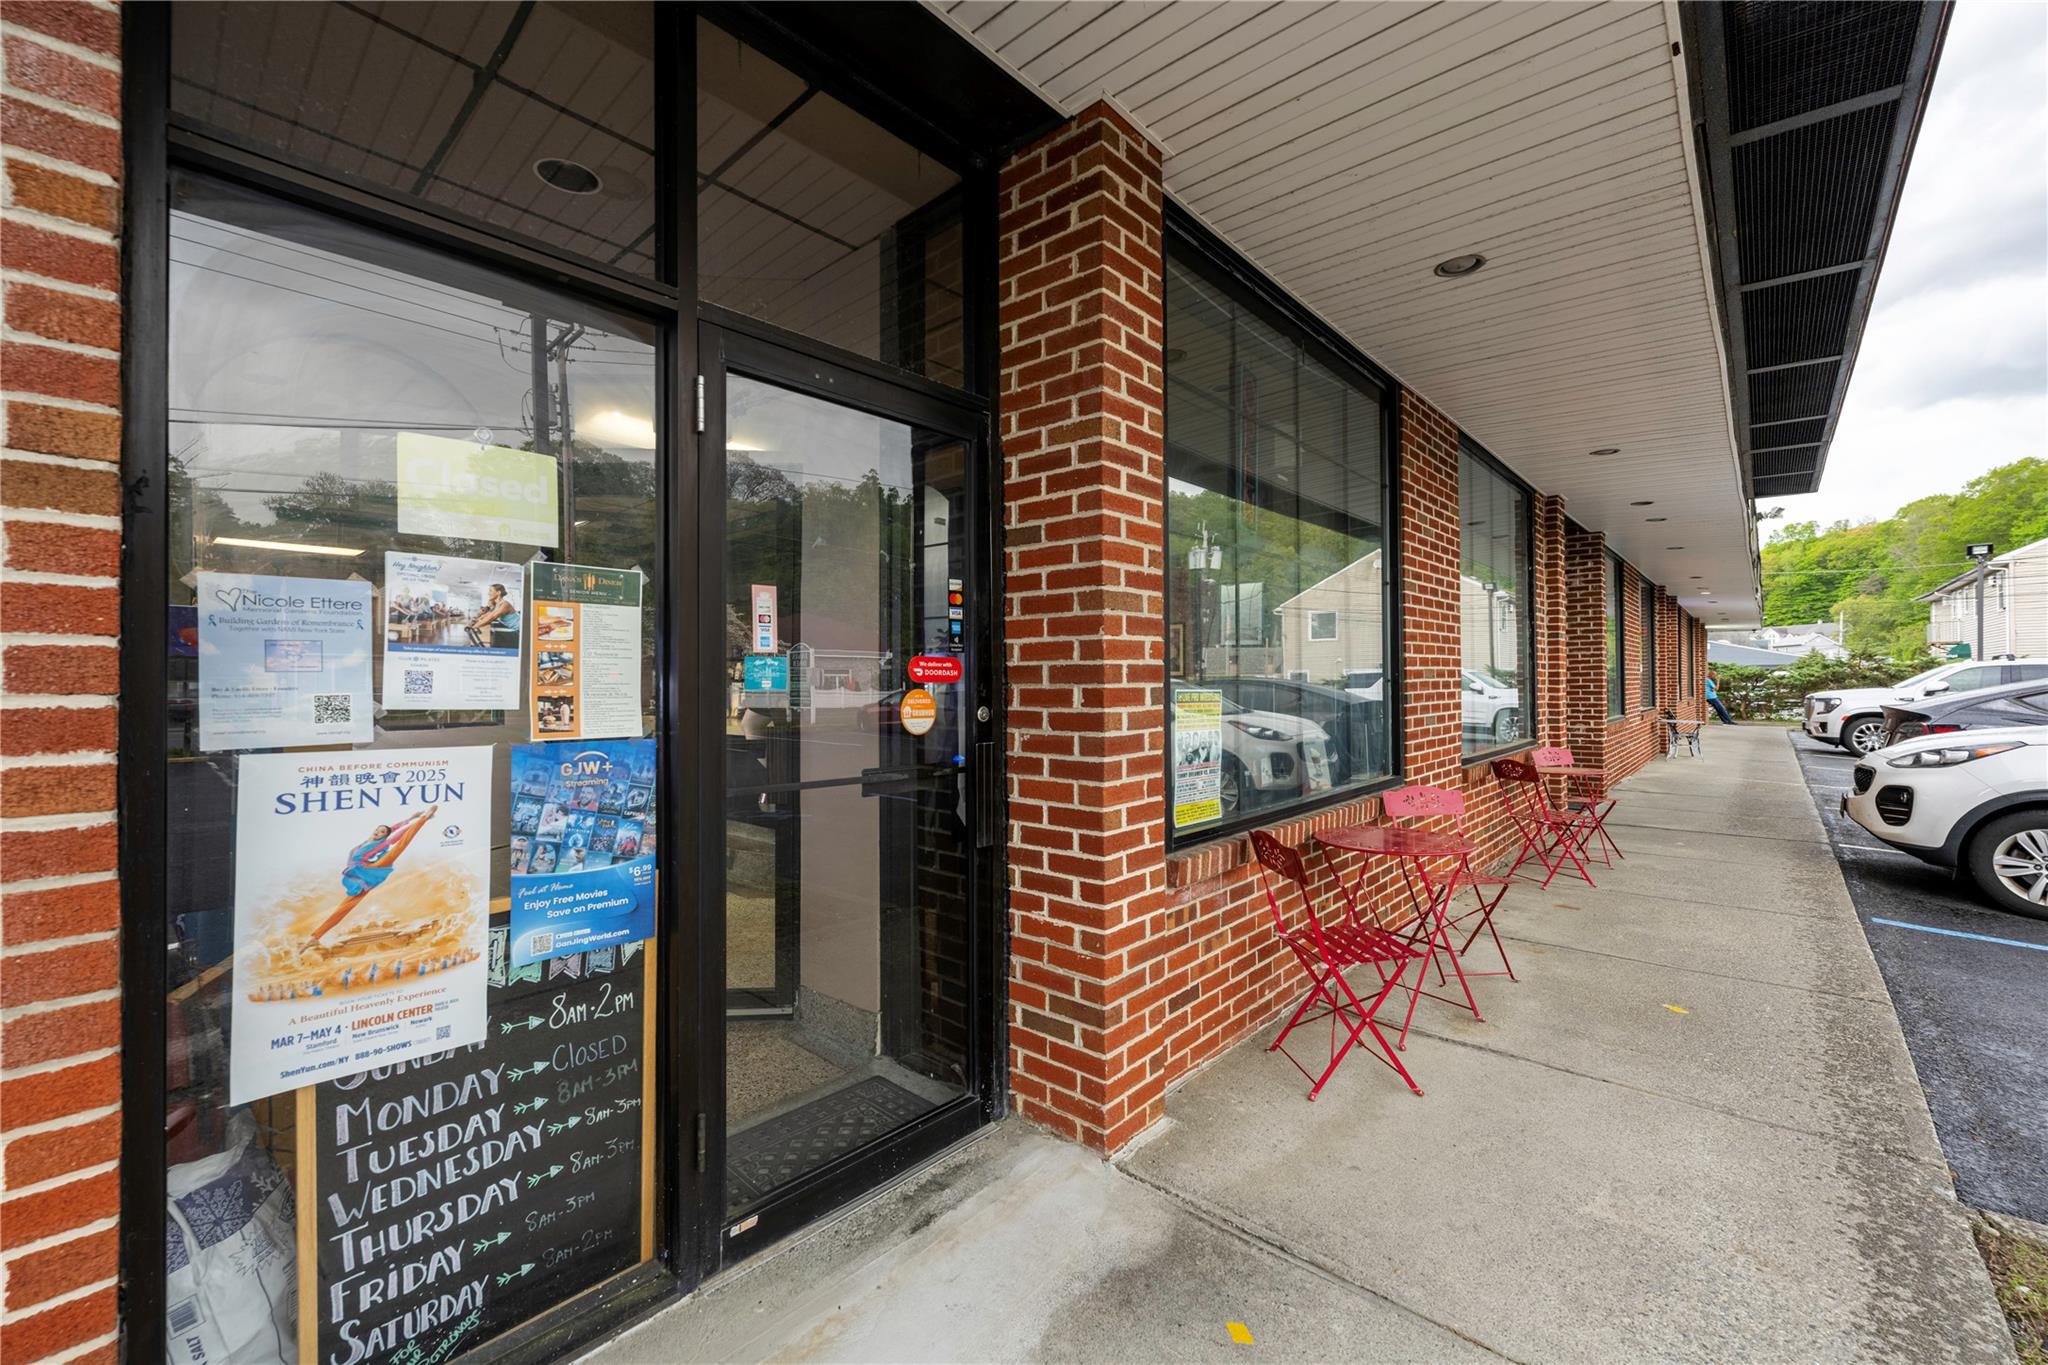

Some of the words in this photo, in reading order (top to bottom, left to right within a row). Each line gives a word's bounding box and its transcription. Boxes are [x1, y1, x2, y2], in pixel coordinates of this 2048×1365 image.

[407, 457, 548, 504] Closed
[242, 593, 304, 608] Nicole
[311, 596, 363, 611] Ettere
[218, 616, 255, 626] Building
[298, 765, 335, 774] CHINA
[339, 763, 383, 772] BEFORE
[386, 759, 449, 769] COMMUNISM
[300, 770, 401, 789] 神韻晚會
[405, 768, 446, 784] 2025
[560, 760, 614, 777] GJW+
[565, 777, 609, 788] Streaming
[274, 787, 382, 816] SHEN
[394, 782, 465, 807] YUN
[628, 863, 652, 877] $6.99
[523, 898, 552, 912] Enjoy
[553, 894, 574, 906] Free
[575, 888, 608, 902] Movies
[547, 908, 571, 919] Save
[573, 905, 586, 914] on
[587, 896, 629, 911] Premium
[288, 1017, 297, 1027] A
[300, 1005, 348, 1025] Beautiful
[351, 995, 395, 1014] Heavenly
[397, 986, 447, 1003] Experience
[270, 1034, 294, 1050] MAR
[334, 1024, 342, 1036] 4
[351, 1012, 395, 1031] LINCOLN
[397, 1003, 433, 1022] CENTER
[305, 1038, 338, 1051] Stamford
[352, 1030, 366, 1039] New
[367, 1023, 400, 1037] Brunswick
[410, 1016, 433, 1027] Newark
[279, 1055, 350, 1080] ShenYun.com/NY
[354, 1039, 413, 1061] 888-90-SHOWS
[335, 1062, 505, 1146] MONDAY
[551, 1034, 627, 1072] CLOSED
[336, 1102, 505, 1184] TUESDAY
[327, 1118, 546, 1228] WEDNESDAY
[329, 1171, 522, 1273] THURSDAY
[330, 1274, 490, 1365] SATURDAY
[186, 1335, 205, 1362] SALT
